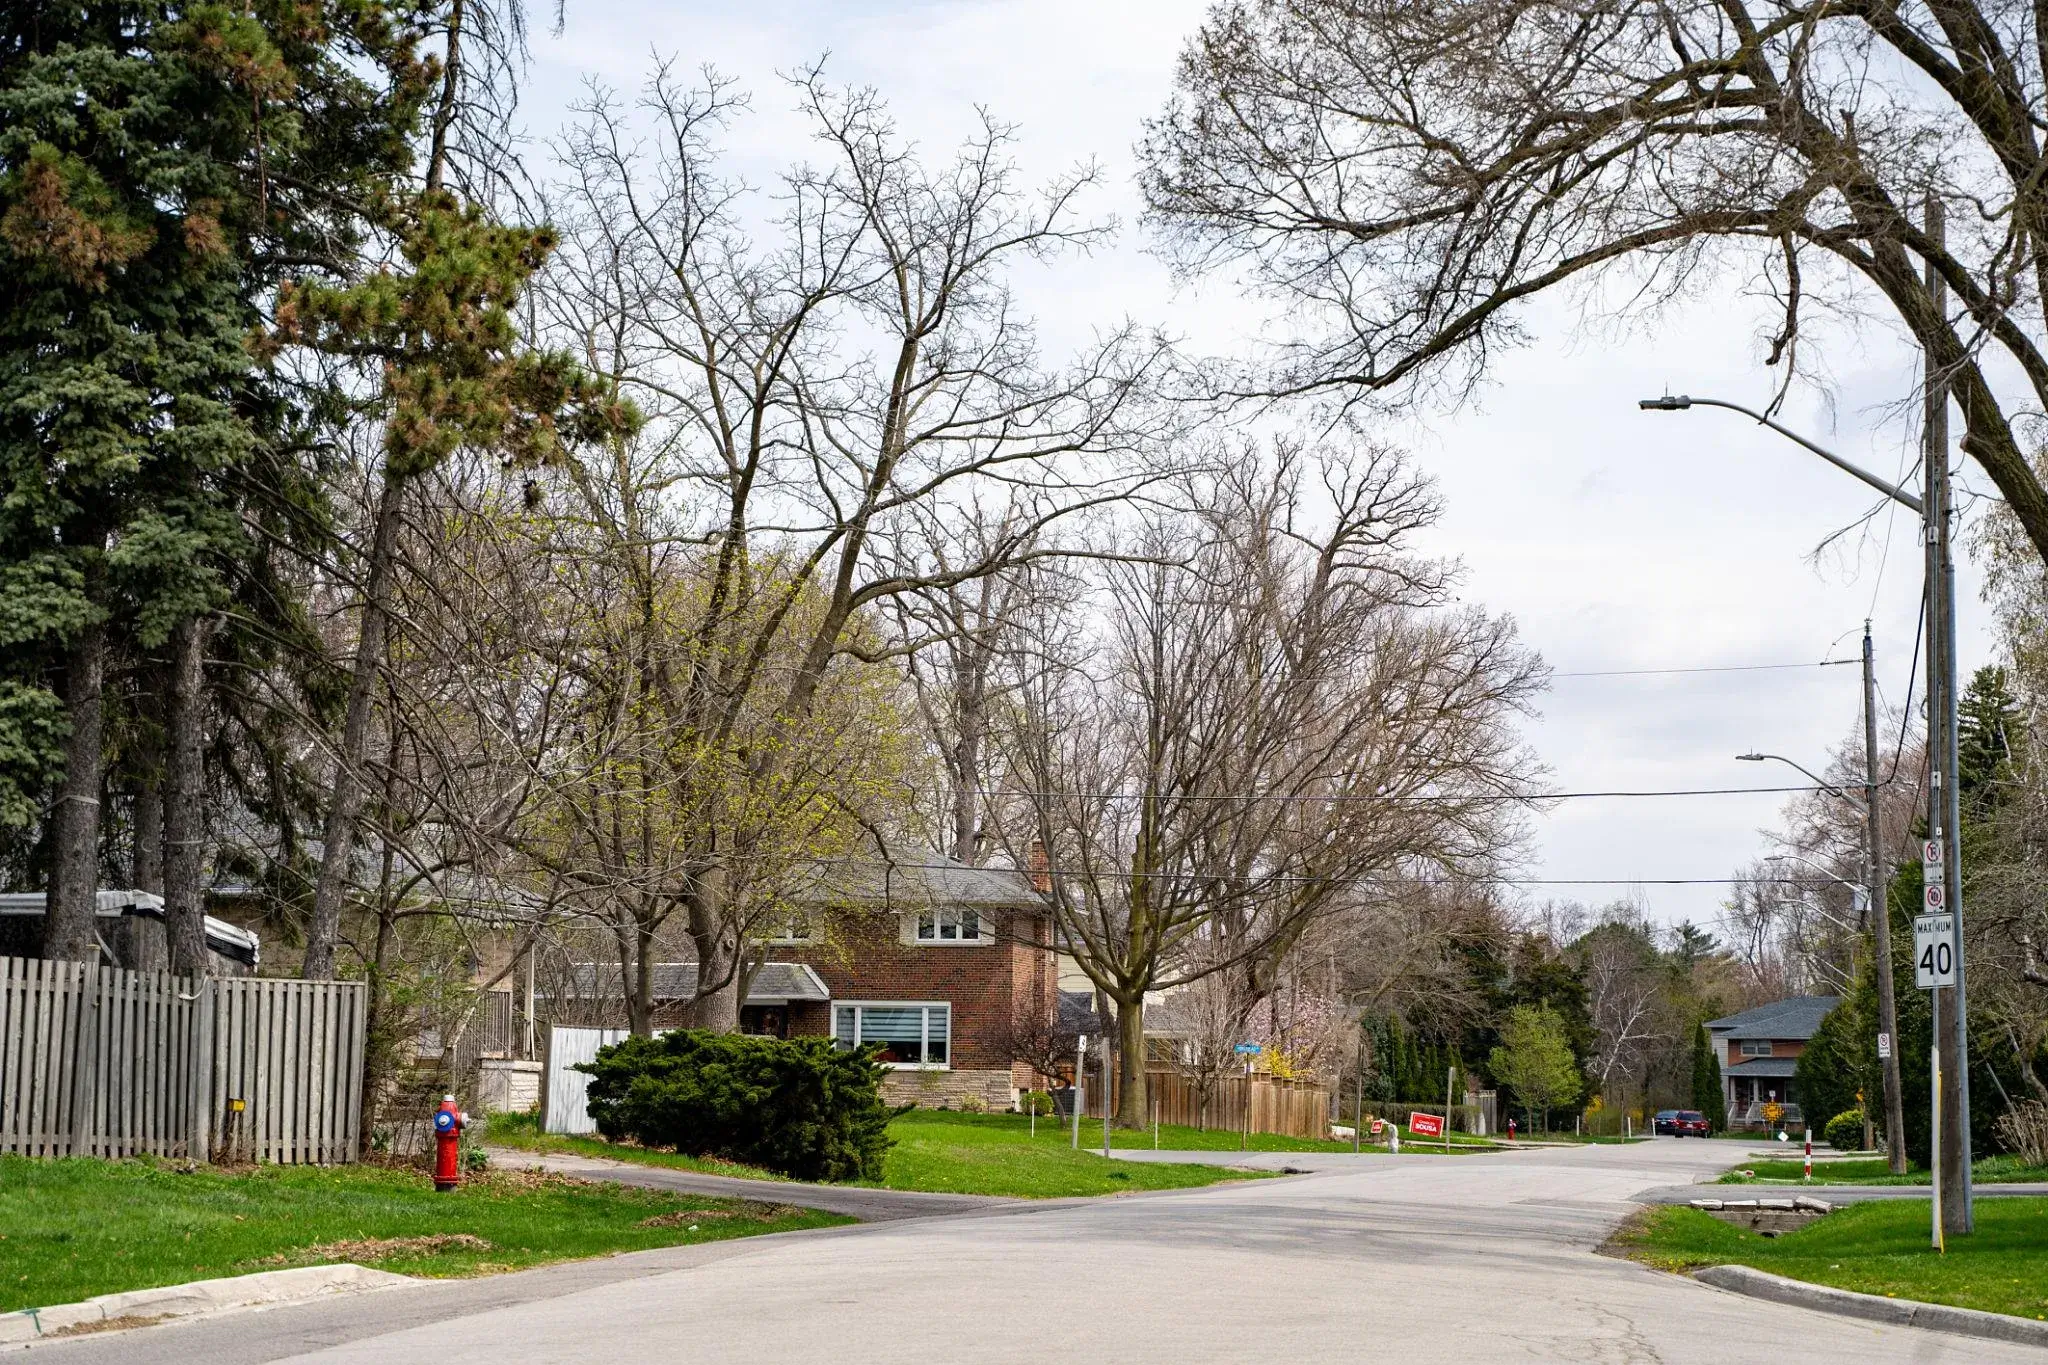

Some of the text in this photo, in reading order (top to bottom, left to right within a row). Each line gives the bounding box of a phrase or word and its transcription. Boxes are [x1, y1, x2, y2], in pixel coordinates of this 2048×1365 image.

[1917, 921, 1951, 934] MAXMUM
[1920, 942, 1952, 975] 40
[1415, 1123, 1437, 1132] SOUSA
